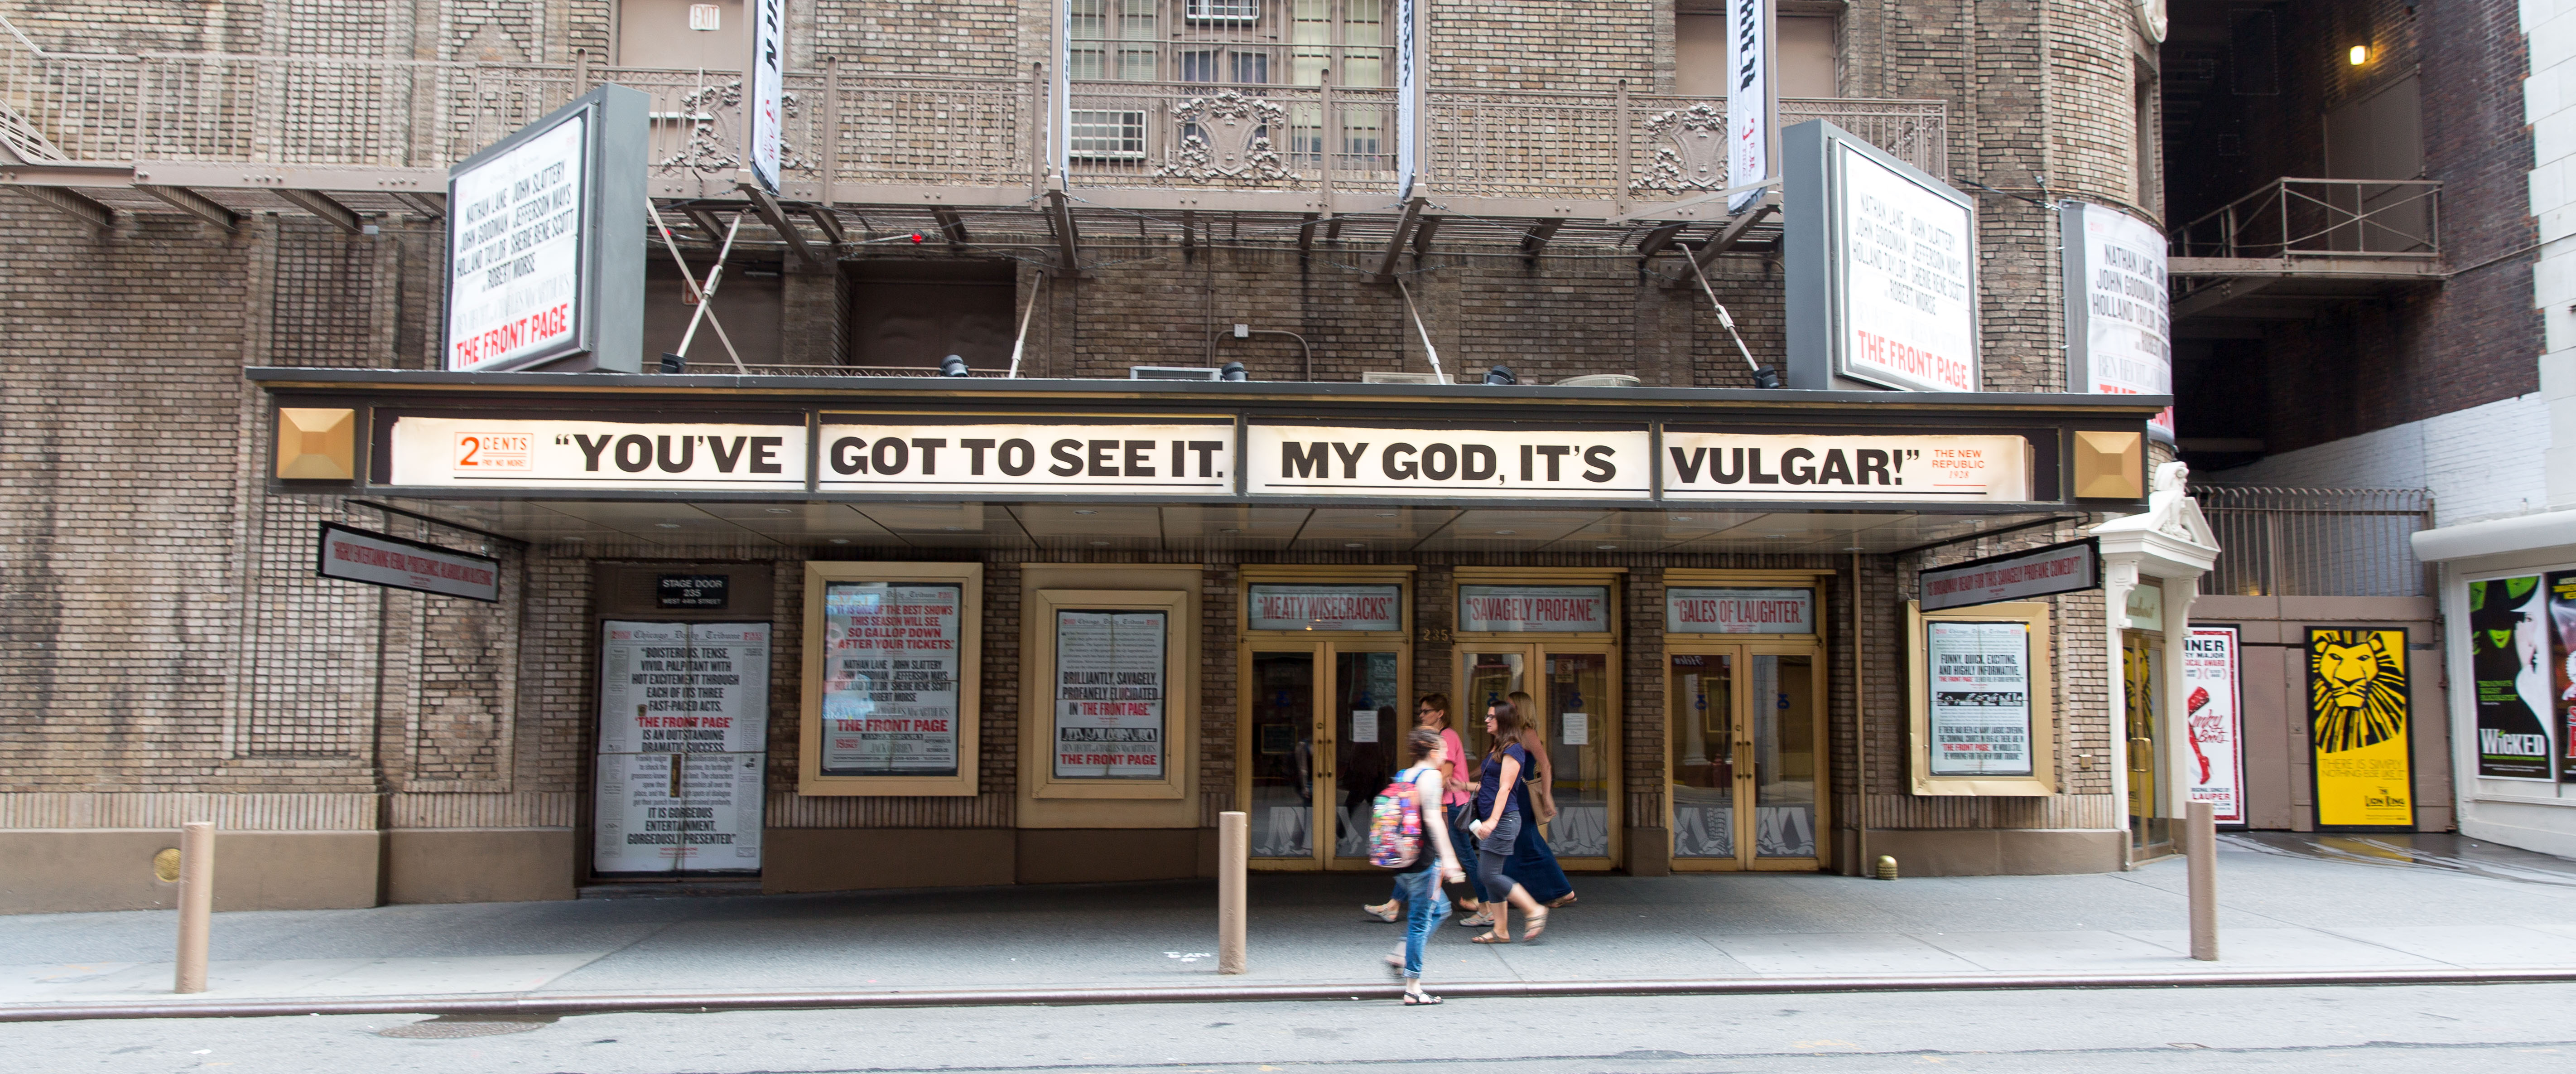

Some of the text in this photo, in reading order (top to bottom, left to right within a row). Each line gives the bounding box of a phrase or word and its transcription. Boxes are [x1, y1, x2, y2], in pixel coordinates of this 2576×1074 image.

[693, 6, 717, 28] EXIT
[2104, 244, 2138, 273] NATHAN
[2096, 268, 2123, 294] JOHN
[2092, 293, 2133, 322] HOLLAND
[457, 336, 480, 369] THE
[483, 318, 527, 359] FRONT
[531, 303, 568, 343] PAGE
[1858, 329, 1886, 364] THE
[1890, 340, 1932, 379] FRONT
[1937, 355, 1968, 391] PAGE
[460, 436, 527, 466] 2 CENTS
[555, 433, 782, 474] "YOU'VE
[830, 435, 1223, 478] GOT TO SEE IT.
[1934, 449, 1982, 459] THE NEW
[1281, 441, 1617, 486] MY GOD, IT'S
[1669, 446, 1920, 486] VULGAR!"
[1932, 459, 1985, 469] REPUBLIC
[1947, 470, 1970, 480] 1928
[662, 579, 723, 588] STAGE DOOR
[683, 589, 702, 597] 235
[886, 605, 901, 615] THE
[903, 605, 922, 615] BEST
[924, 605, 953, 616] SHOWS
[1258, 596, 1305, 619] "MEATY
[1465, 598, 1533, 621] "SAVAGELY
[1673, 600, 1716, 623] "GALES
[1719, 600, 1735, 623] OF
[851, 616, 869, 626] THIS
[871, 616, 902, 626] SEASON
[904, 616, 923, 626] WILL
[847, 627, 942, 638] SO GALLOP DOWN
[1422, 629, 1449, 642] 235
[838, 639, 873, 649] AFTER
[875, 639, 904, 649] YOUR
[710, 661, 732, 672] WITH
[843, 659, 943, 670] NATHAN LANE JOHN SLATTERY
[1938, 665, 1952, 675] AND
[1953, 665, 1975, 675] HIGHLY
[632, 673, 740, 685] HOT EXCITEMENT THROUGH
[893, 671, 949, 680] JEFFERSON MAYS
[931, 682, 952, 692] SCOTT
[646, 687, 669, 698] EACH
[669, 687, 682, 698] OF
[697, 687, 725, 699] THREE
[894, 692, 917, 702] MORSE
[1062, 687, 1158, 701] PROFANELY ELUCIDATED
[649, 700, 698, 711] FAST-PACED
[1069, 702, 1079, 716] IN
[1099, 702, 1126, 716] FRONT
[662, 716, 700, 728] FRONT
[836, 719, 949, 732] THE FRONT PAGE
[642, 729, 725, 740] IS AN OUTSTANDING
[641, 742, 685, 752] DRAMATIC
[1060, 754, 1157, 765] THE FRONT PAGE
[2356, 759, 2366, 769] IS
[2369, 759, 2403, 770] SIMPLY
[2321, 769, 2363, 778] NOTHING
[2364, 795, 2406, 807] LION KING
[648, 807, 714, 818] IT IS GORGEOUS
[627, 833, 682, 844] GORGEOUSLY
